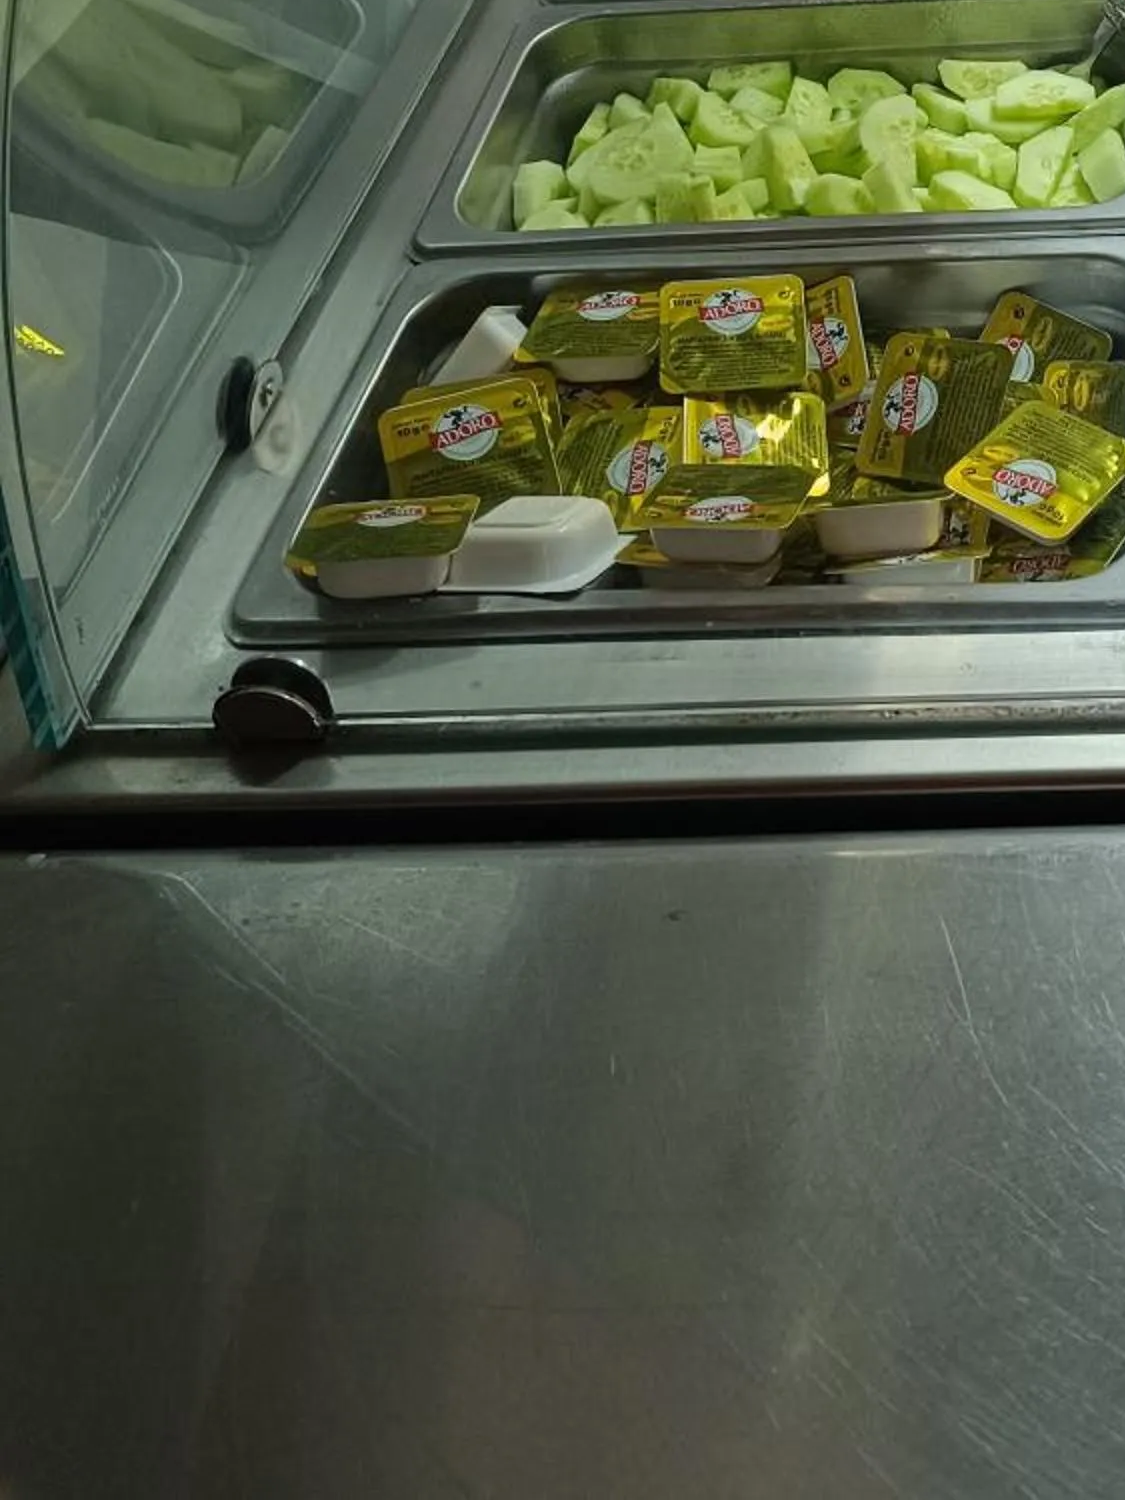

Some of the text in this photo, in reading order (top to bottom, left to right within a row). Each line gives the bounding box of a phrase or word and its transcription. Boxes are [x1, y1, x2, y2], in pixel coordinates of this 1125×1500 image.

[704, 300, 762, 319] ADORO
[900, 374, 919, 430] ADORO
[436, 413, 496, 448] ADORO
[994, 469, 1054, 497] ADORO
